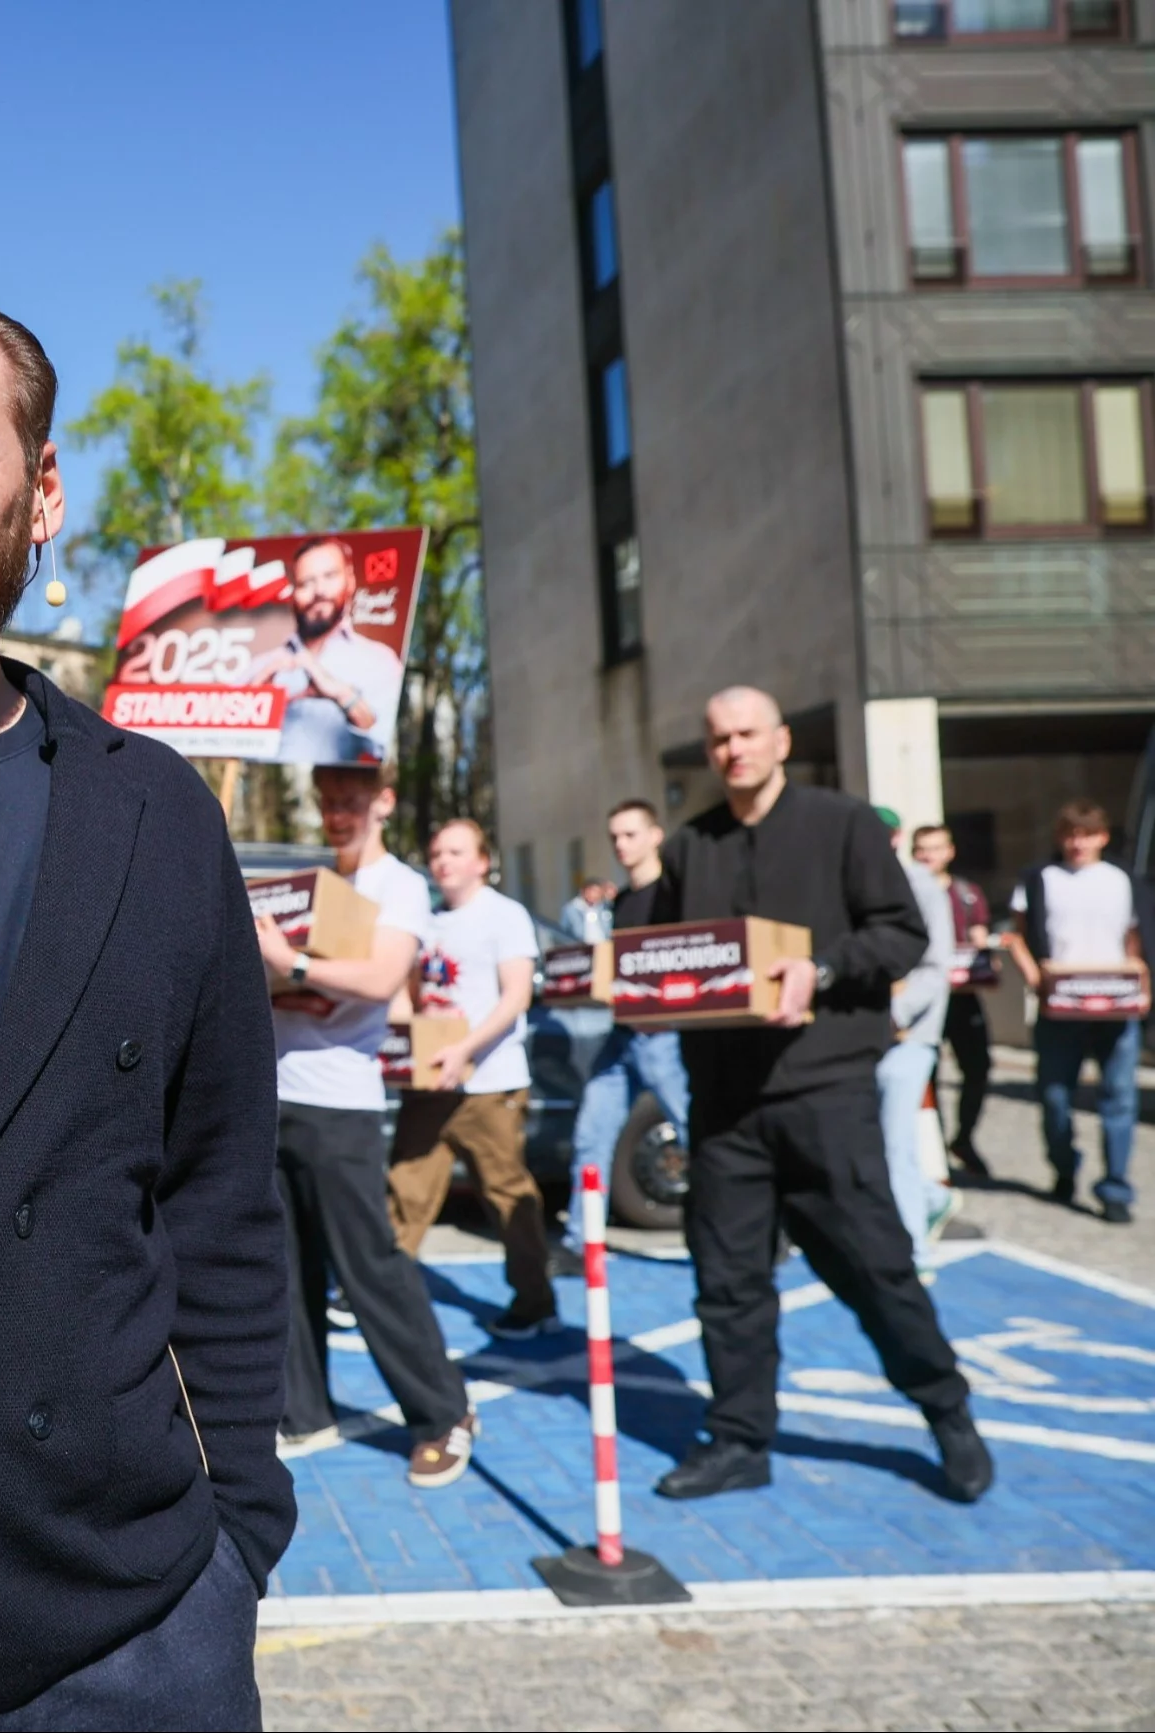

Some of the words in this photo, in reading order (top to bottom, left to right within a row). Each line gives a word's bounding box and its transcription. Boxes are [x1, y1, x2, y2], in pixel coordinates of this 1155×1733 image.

[118, 628, 254, 685] 2025
[112, 692, 273, 725] STANOWSKI
[618, 942, 742, 977] STANOWSKI
